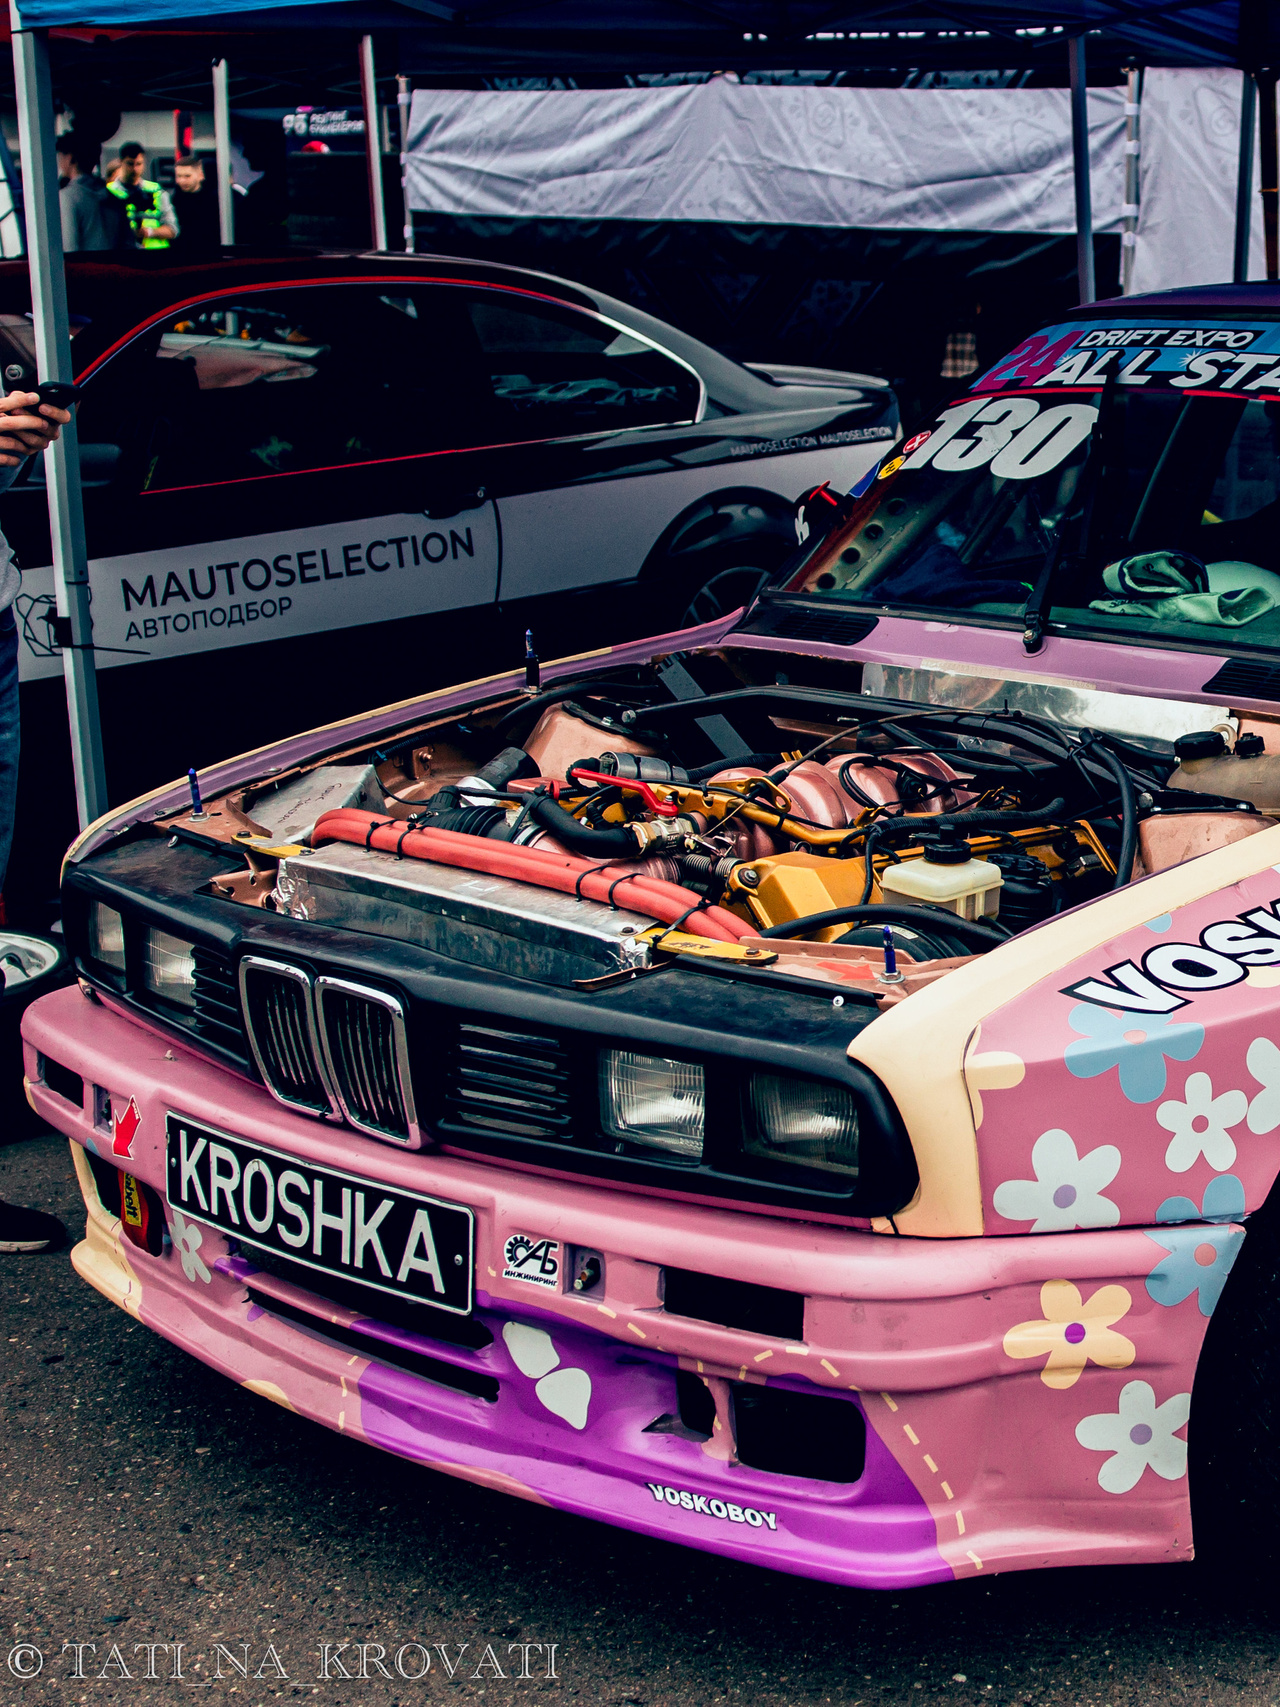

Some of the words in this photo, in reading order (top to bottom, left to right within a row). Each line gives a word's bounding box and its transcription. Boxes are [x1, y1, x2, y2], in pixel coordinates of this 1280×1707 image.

[971, 330, 1085, 392] 24
[1033, 350, 1159, 386] ALL
[1078, 330, 1160, 347] DRIFT
[1174, 330, 1255, 348] EXPO
[730, 436, 818, 457] MAUTOSELECTION
[819, 425, 894, 445] MAUTOSELECTION
[899, 397, 1100, 480] 130
[121, 527, 474, 611] MAUTOSELECTION
[125, 596, 292, 641] АВТОПОДБОР
[180, 1129, 445, 1294] KROSHKA
[504, 1270, 558, 1287] ИНЖИНИРИНГ
[645, 1483, 778, 1531] VOSKOBOY
